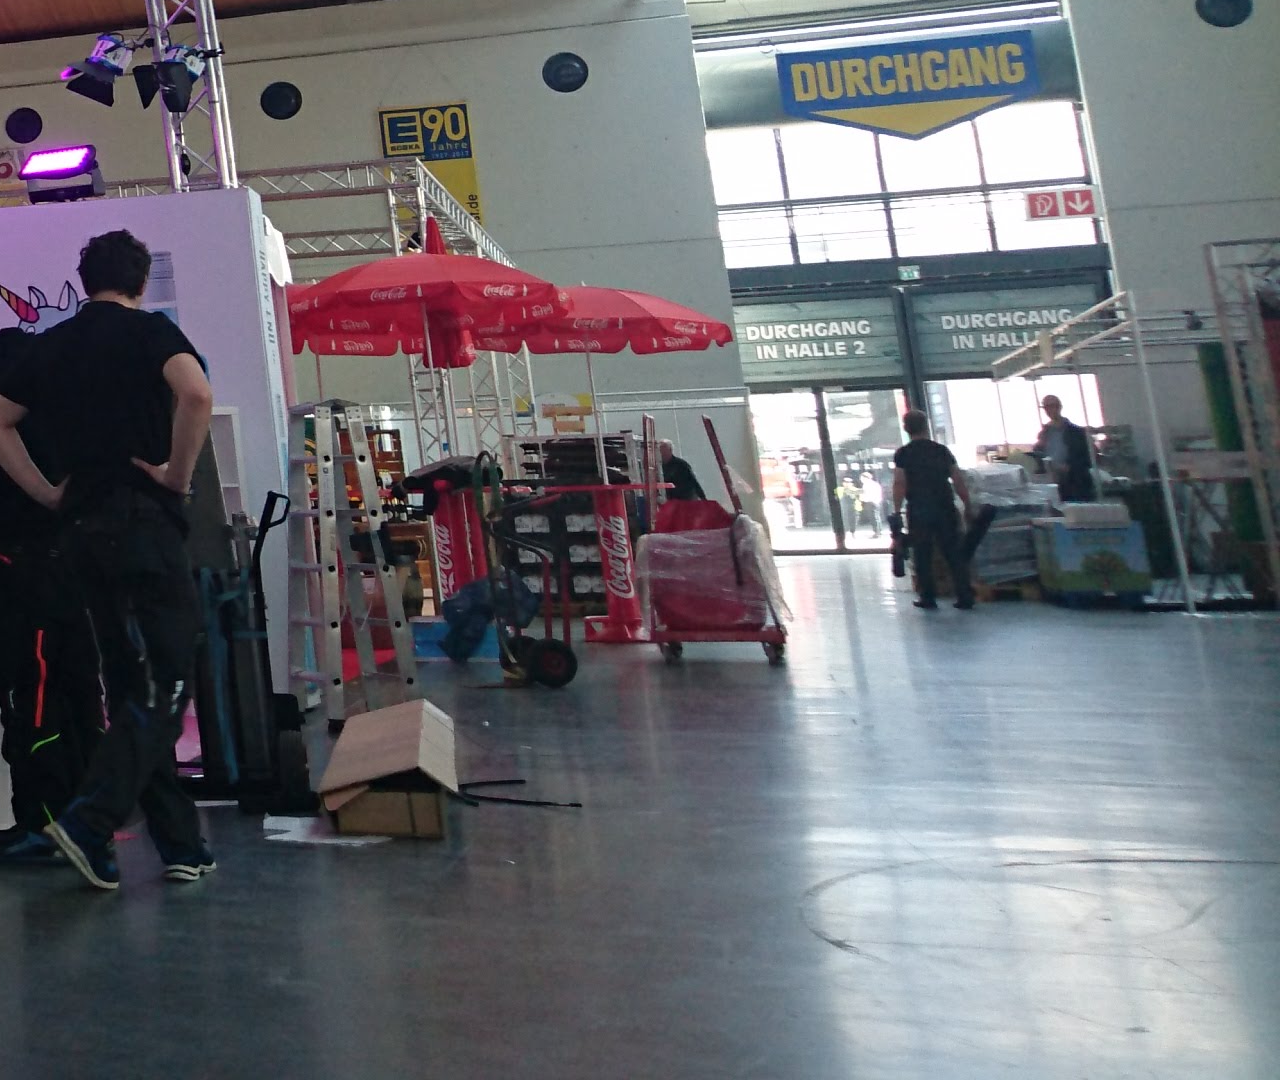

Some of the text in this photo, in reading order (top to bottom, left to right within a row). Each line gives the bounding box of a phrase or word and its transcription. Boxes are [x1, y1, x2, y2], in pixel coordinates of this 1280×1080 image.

[791, 43, 1026, 102] DURCHGANG
[940, 308, 1073, 330] DURCHGANG
[746, 320, 871, 341] DURCHGANG
[755, 340, 866, 360] IN HALLE 2
[952, 334, 975, 349] IN
